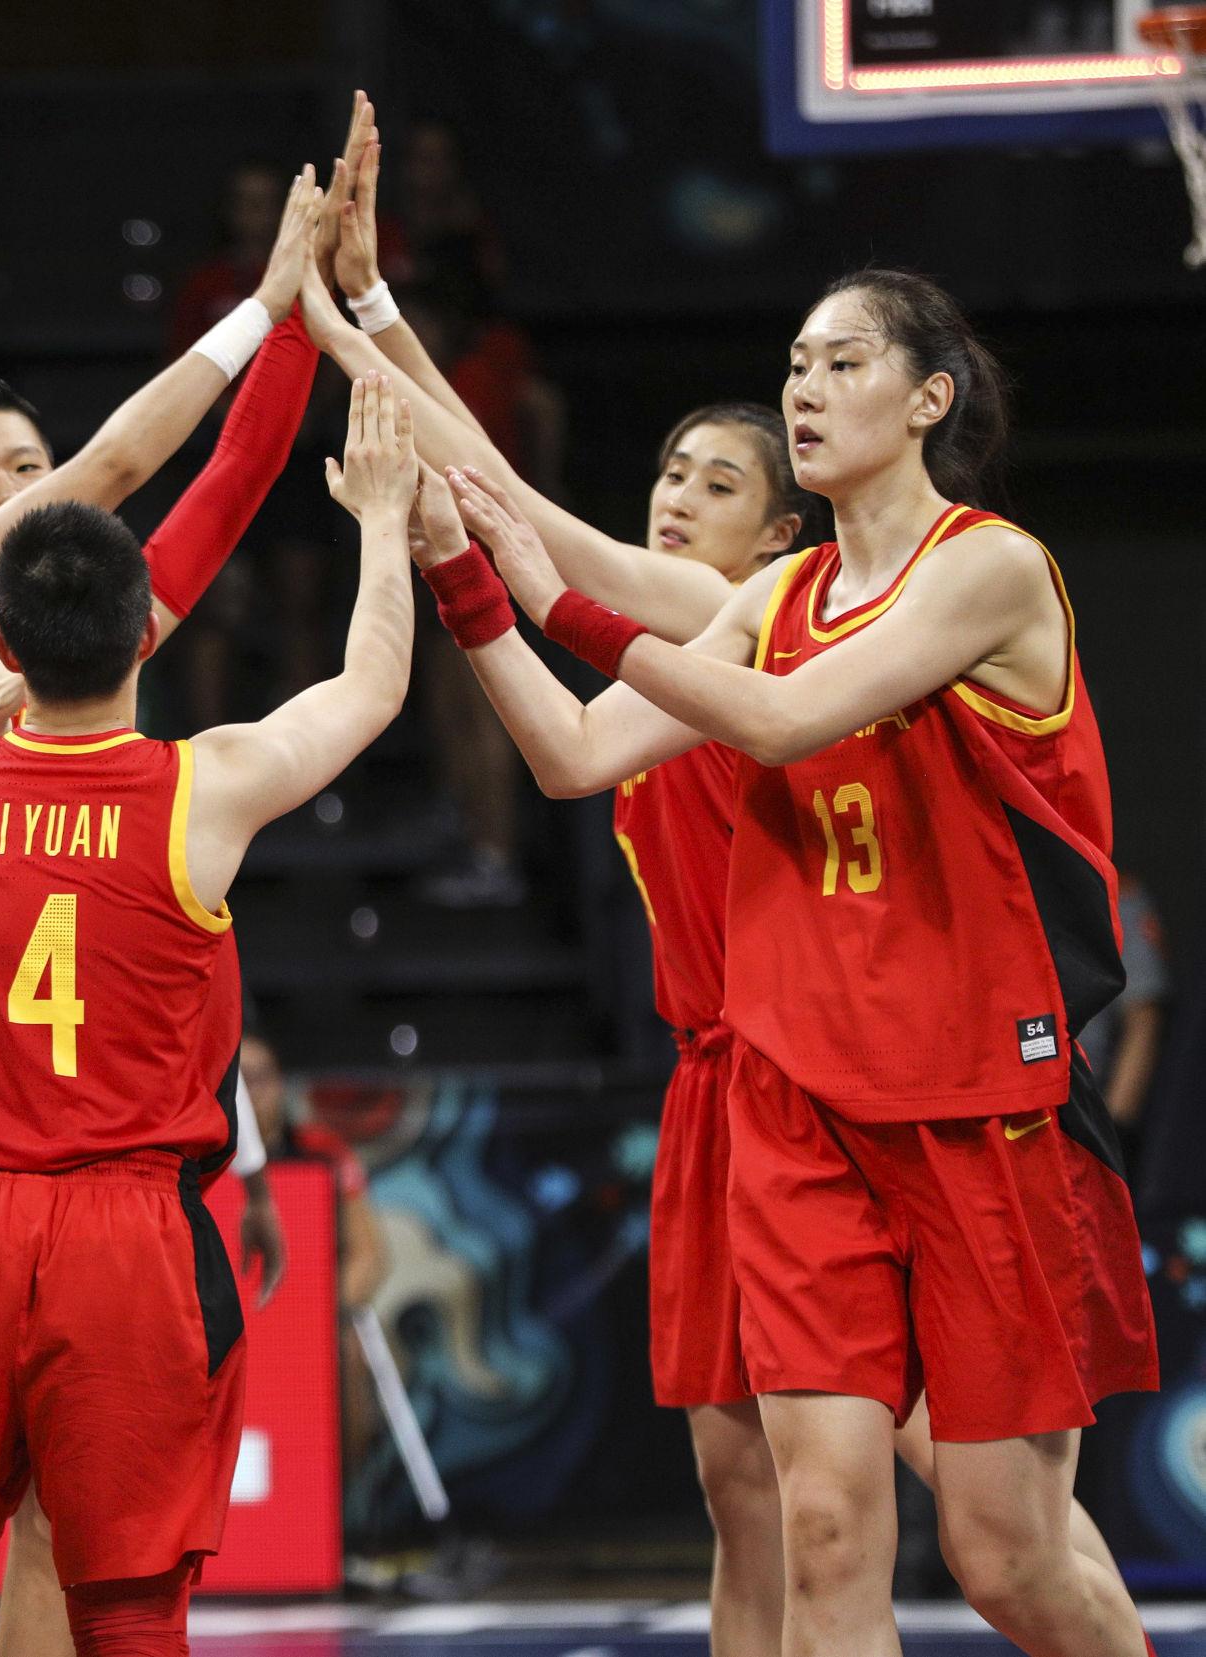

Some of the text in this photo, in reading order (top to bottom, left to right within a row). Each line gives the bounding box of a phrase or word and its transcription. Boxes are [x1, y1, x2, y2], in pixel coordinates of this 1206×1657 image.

[24, 804, 122, 859] YUAN
[813, 782, 883, 897] 13
[8, 893, 85, 1078] 4
[1026, 1021, 1046, 1037] 54
